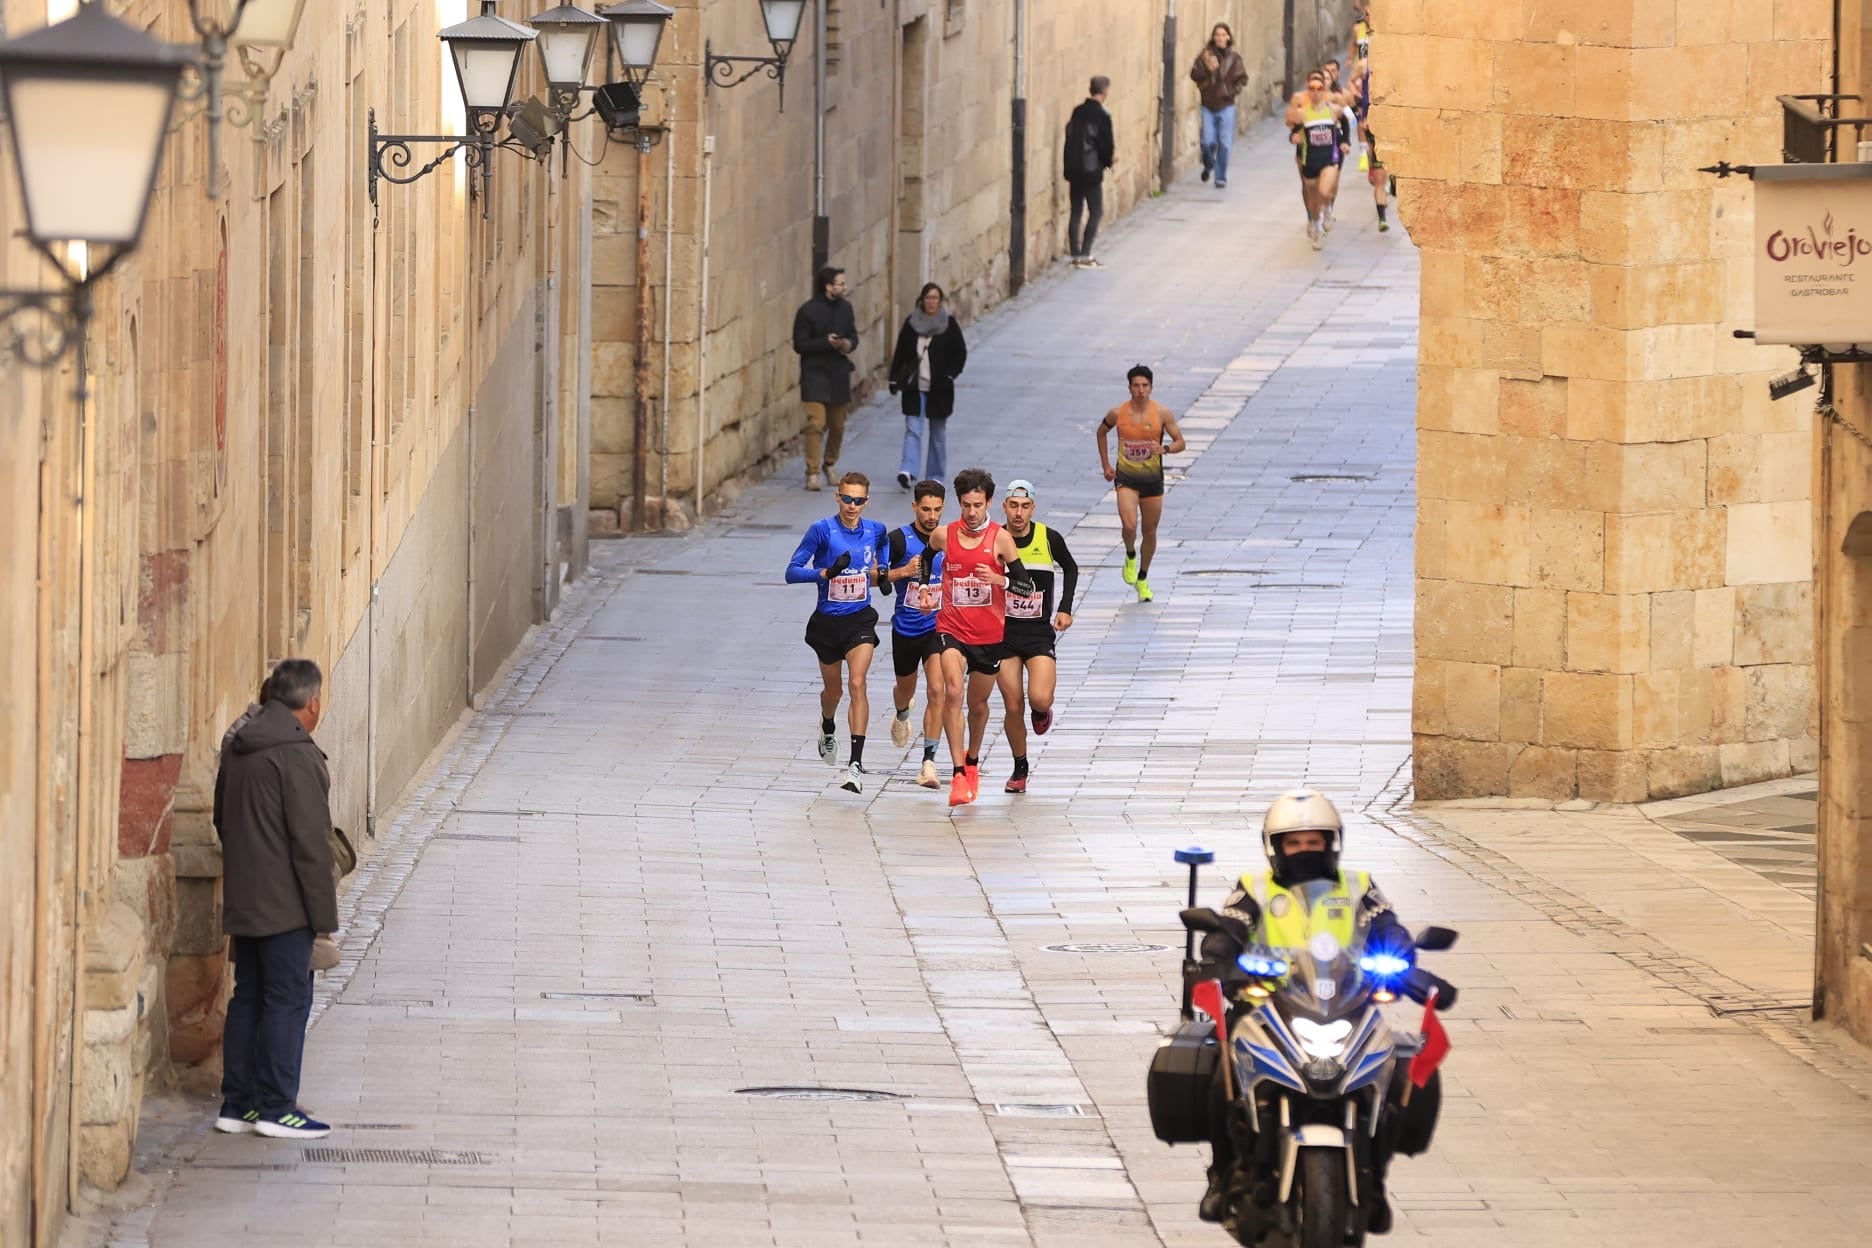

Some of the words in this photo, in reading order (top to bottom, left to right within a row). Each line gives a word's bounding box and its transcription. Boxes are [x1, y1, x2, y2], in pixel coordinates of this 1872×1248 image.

[1784, 273, 1855, 283] RESTAURANTE
[1791, 288, 1849, 297] GASTROBAR
[842, 584, 855, 593] 11
[965, 587, 980, 598] 13
[1013, 600, 1034, 610] 544
